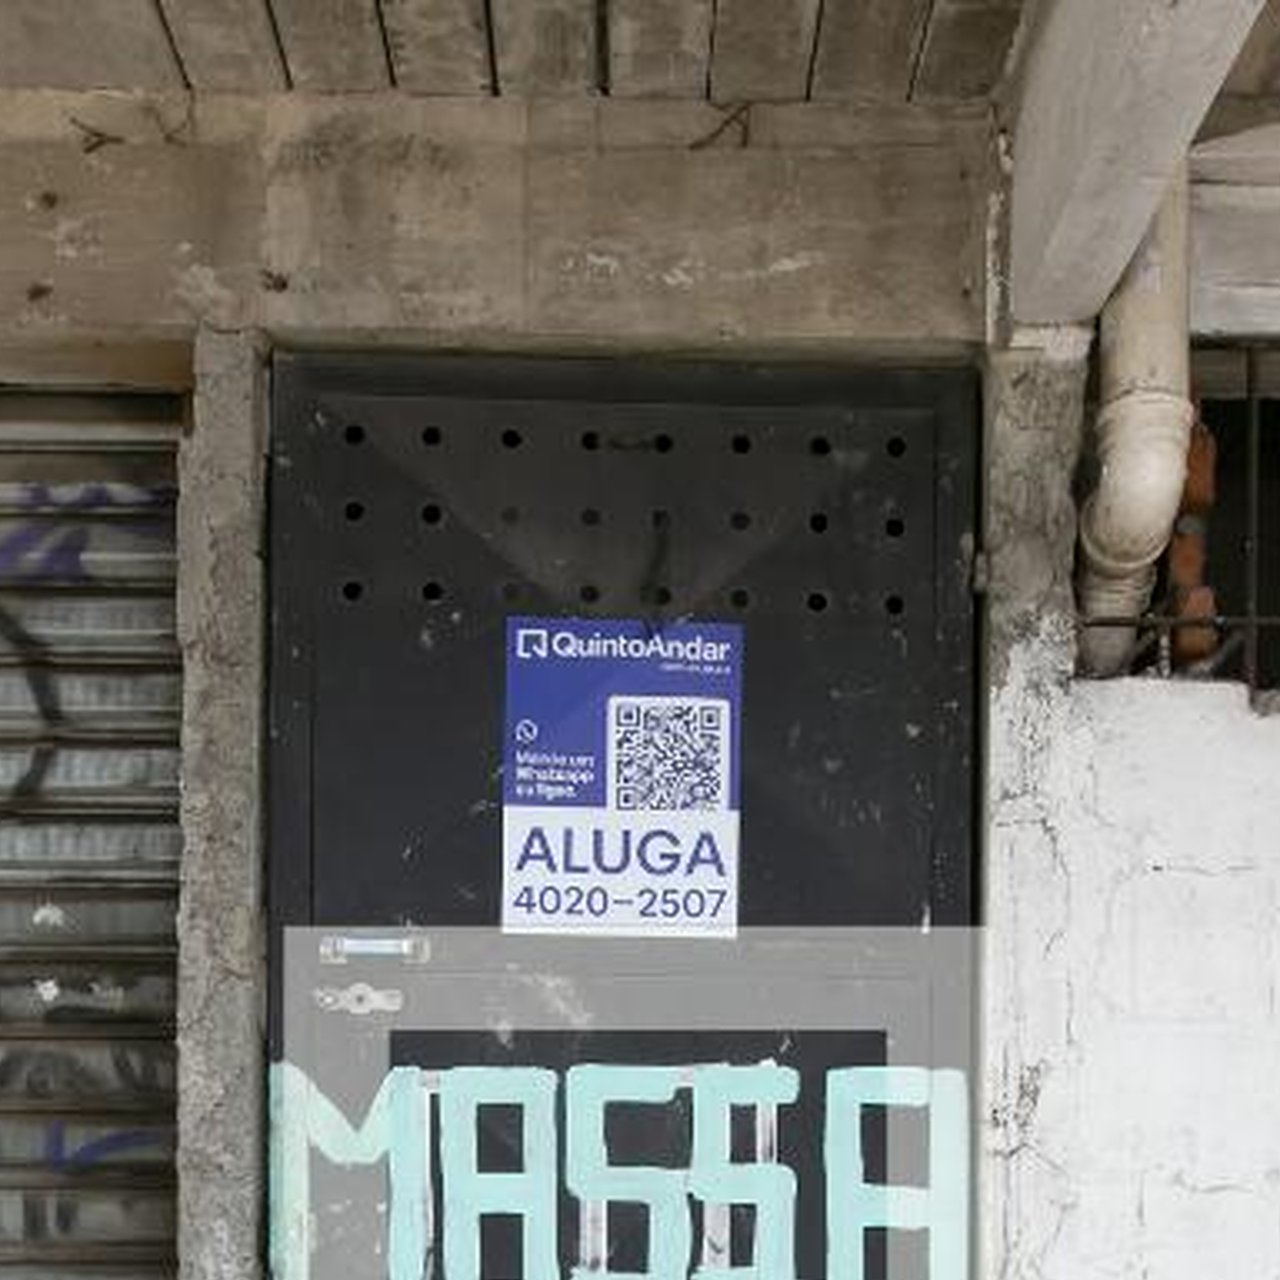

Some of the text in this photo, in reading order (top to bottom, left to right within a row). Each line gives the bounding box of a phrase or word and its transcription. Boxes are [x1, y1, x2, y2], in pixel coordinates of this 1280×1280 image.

[552, 631, 731, 661] QuintoAndar
[515, 826, 727, 877] ALUGA
[513, 886, 728, 918] 4020-2507
